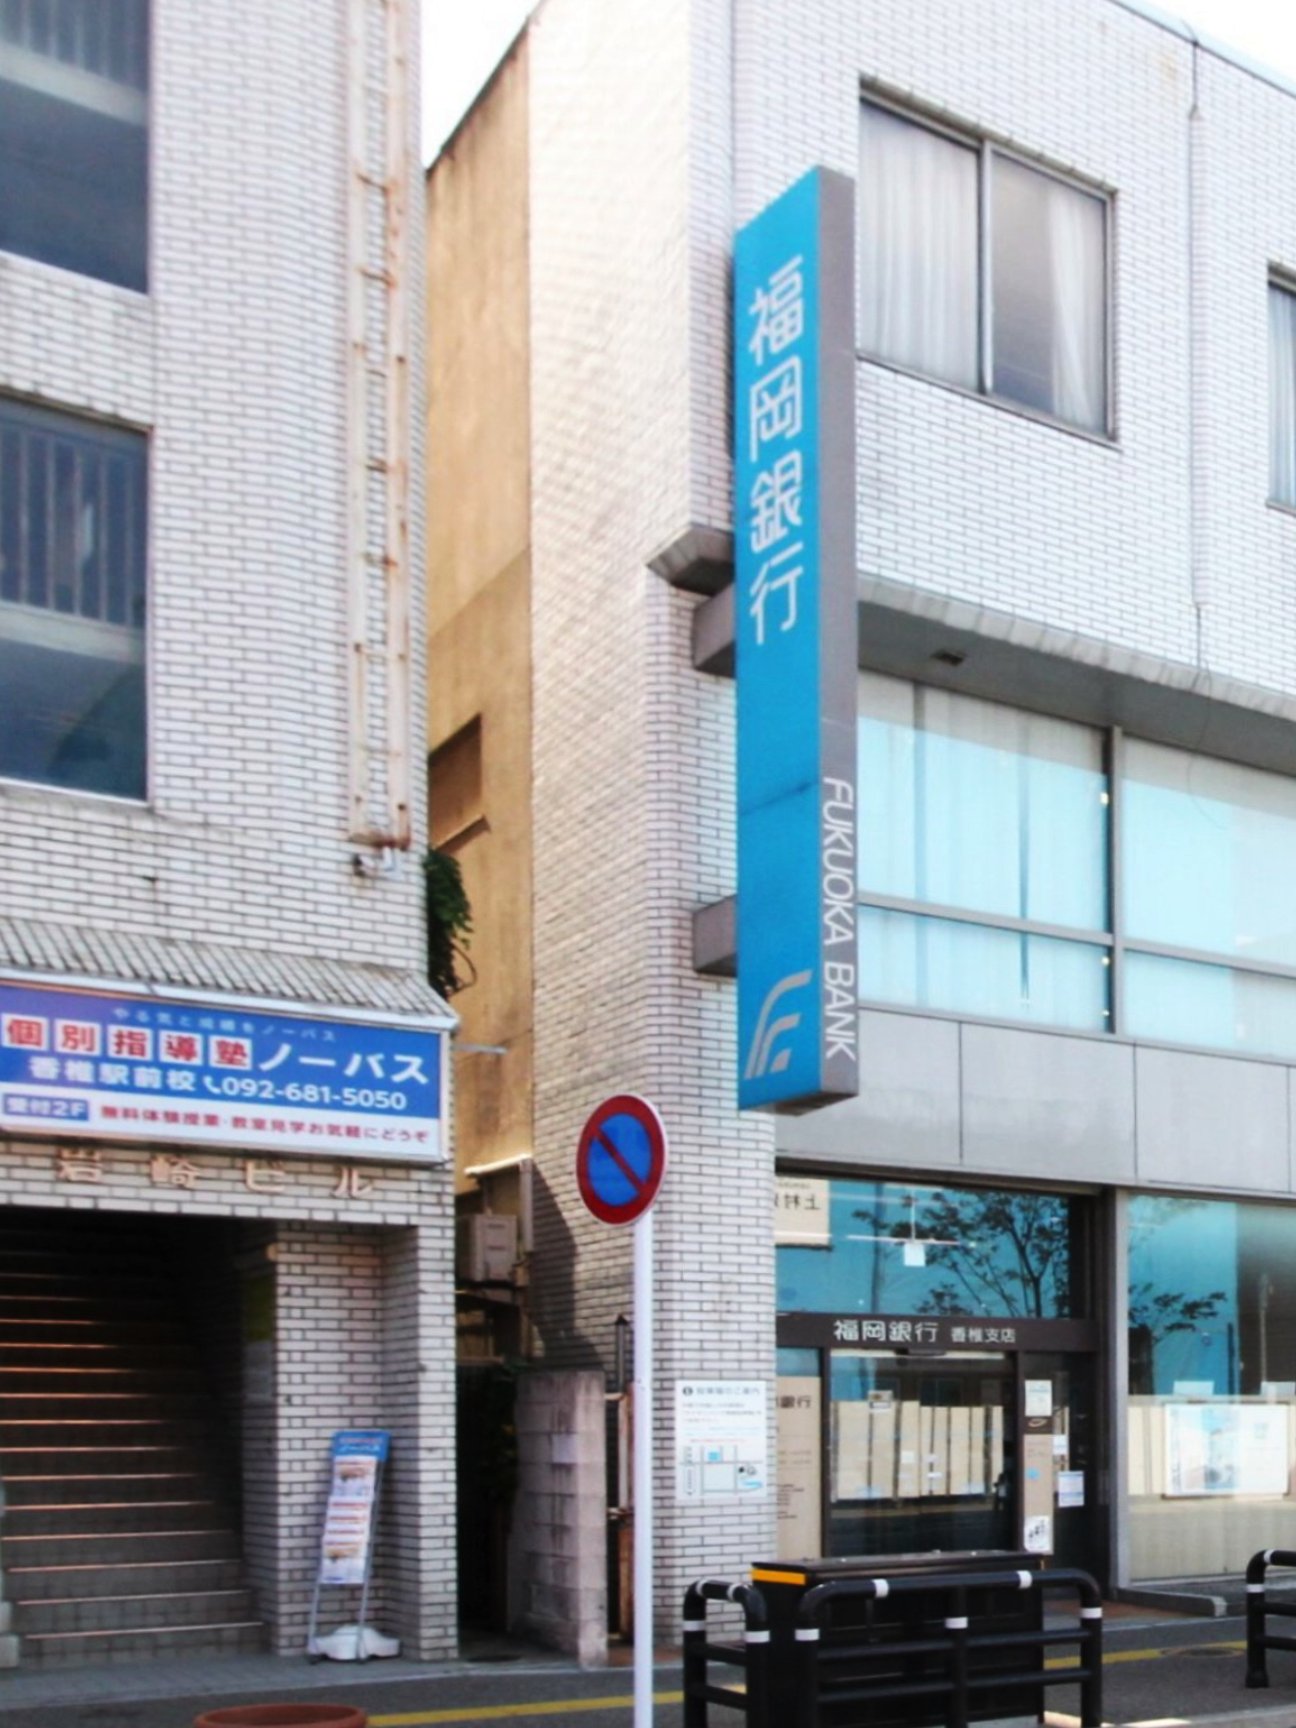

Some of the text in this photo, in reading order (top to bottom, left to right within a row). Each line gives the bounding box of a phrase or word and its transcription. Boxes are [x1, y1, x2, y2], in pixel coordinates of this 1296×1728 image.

[749, 255, 803, 645] 福岡銀行
[822, 777, 856, 1061] FUKUOKA BANK
[221, 1076, 407, 1111] 092-681-5050
[57, 1147, 374, 1198] 岩崎ビル
[833, 1320, 1017, 1344] 福岡銀行 香椎支店
